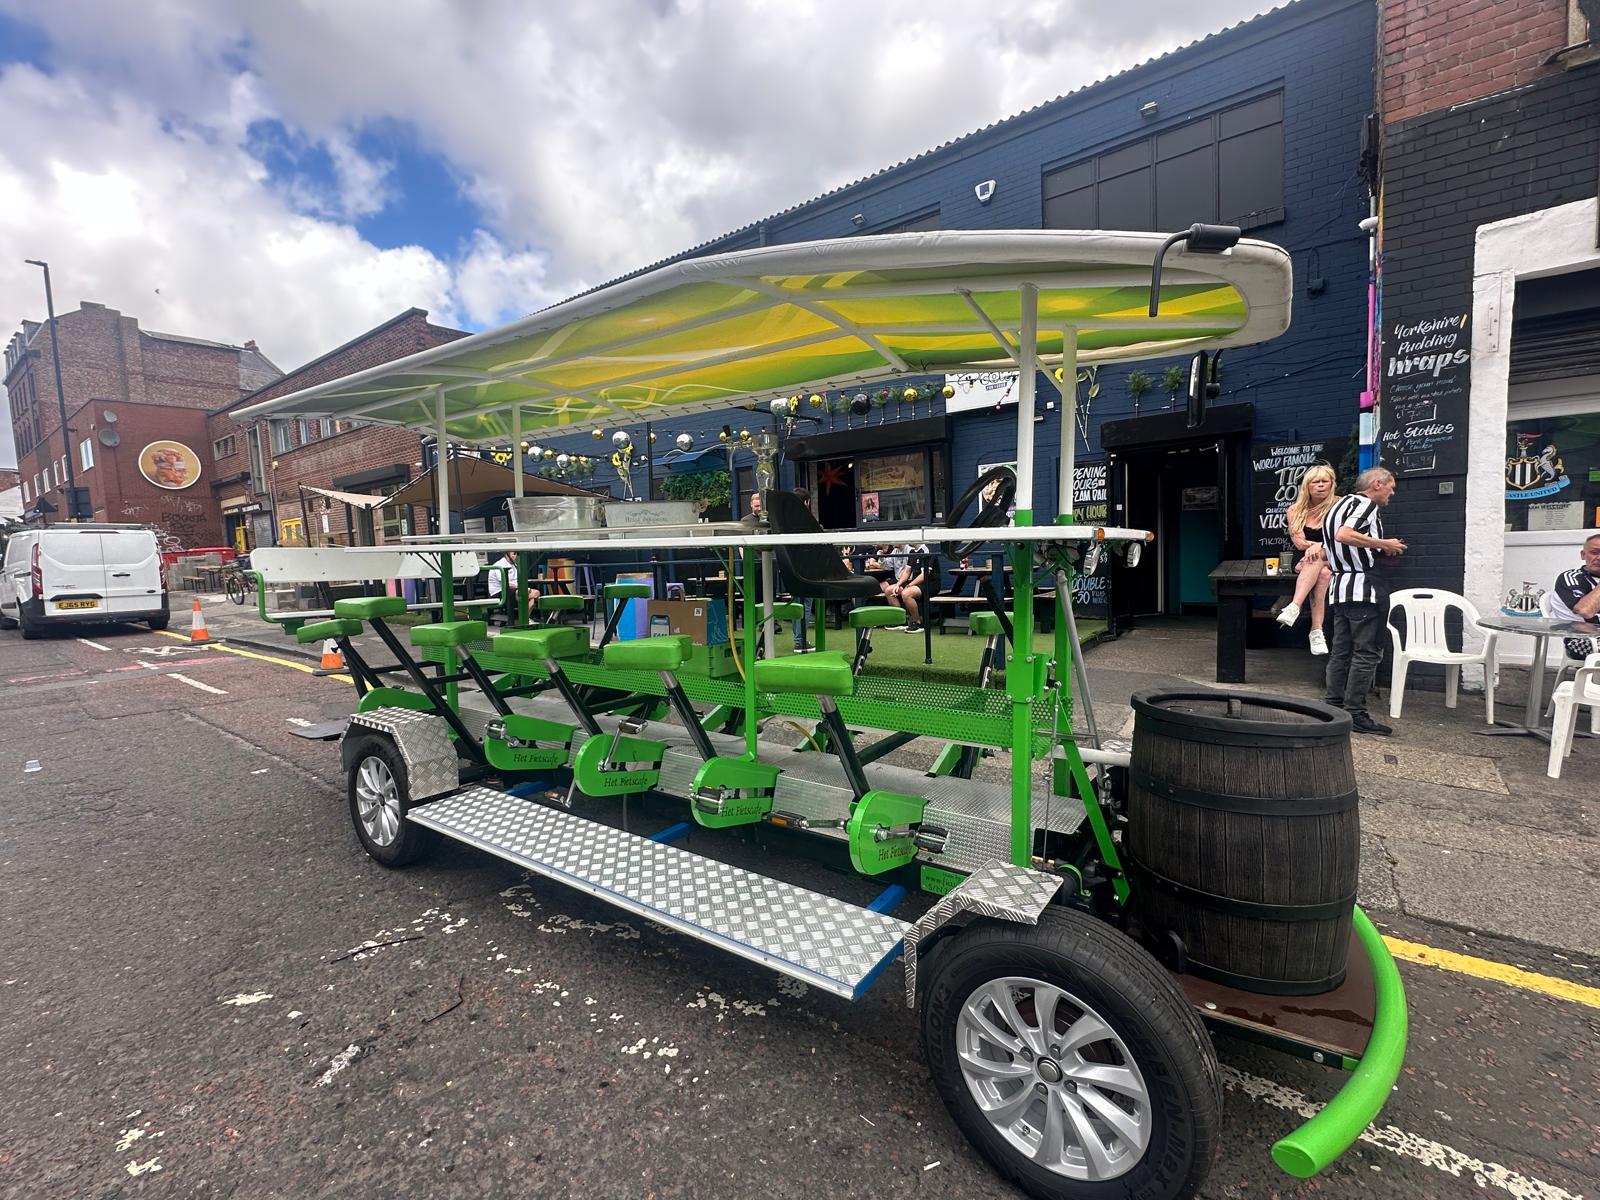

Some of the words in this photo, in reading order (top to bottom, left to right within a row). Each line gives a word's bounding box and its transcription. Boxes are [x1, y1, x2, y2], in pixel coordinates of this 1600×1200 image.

[1394, 315, 1460, 339] Yorkshire
[1383, 429, 1400, 441] Hot
[1271, 446, 1300, 456] WELCOME
[1303, 445, 1310, 453] TO
[1253, 457, 1281, 472] WORLD
[1283, 453, 1317, 467] FAMOUS
[1072, 466, 1107, 479] PENING
[1073, 478, 1098, 490] OURS
[1275, 485, 1299, 501] CO
[513, 753, 527, 762] Het
[604, 777, 617, 788] Het
[721, 806, 734, 817] Het
[878, 848, 889, 861] Het
